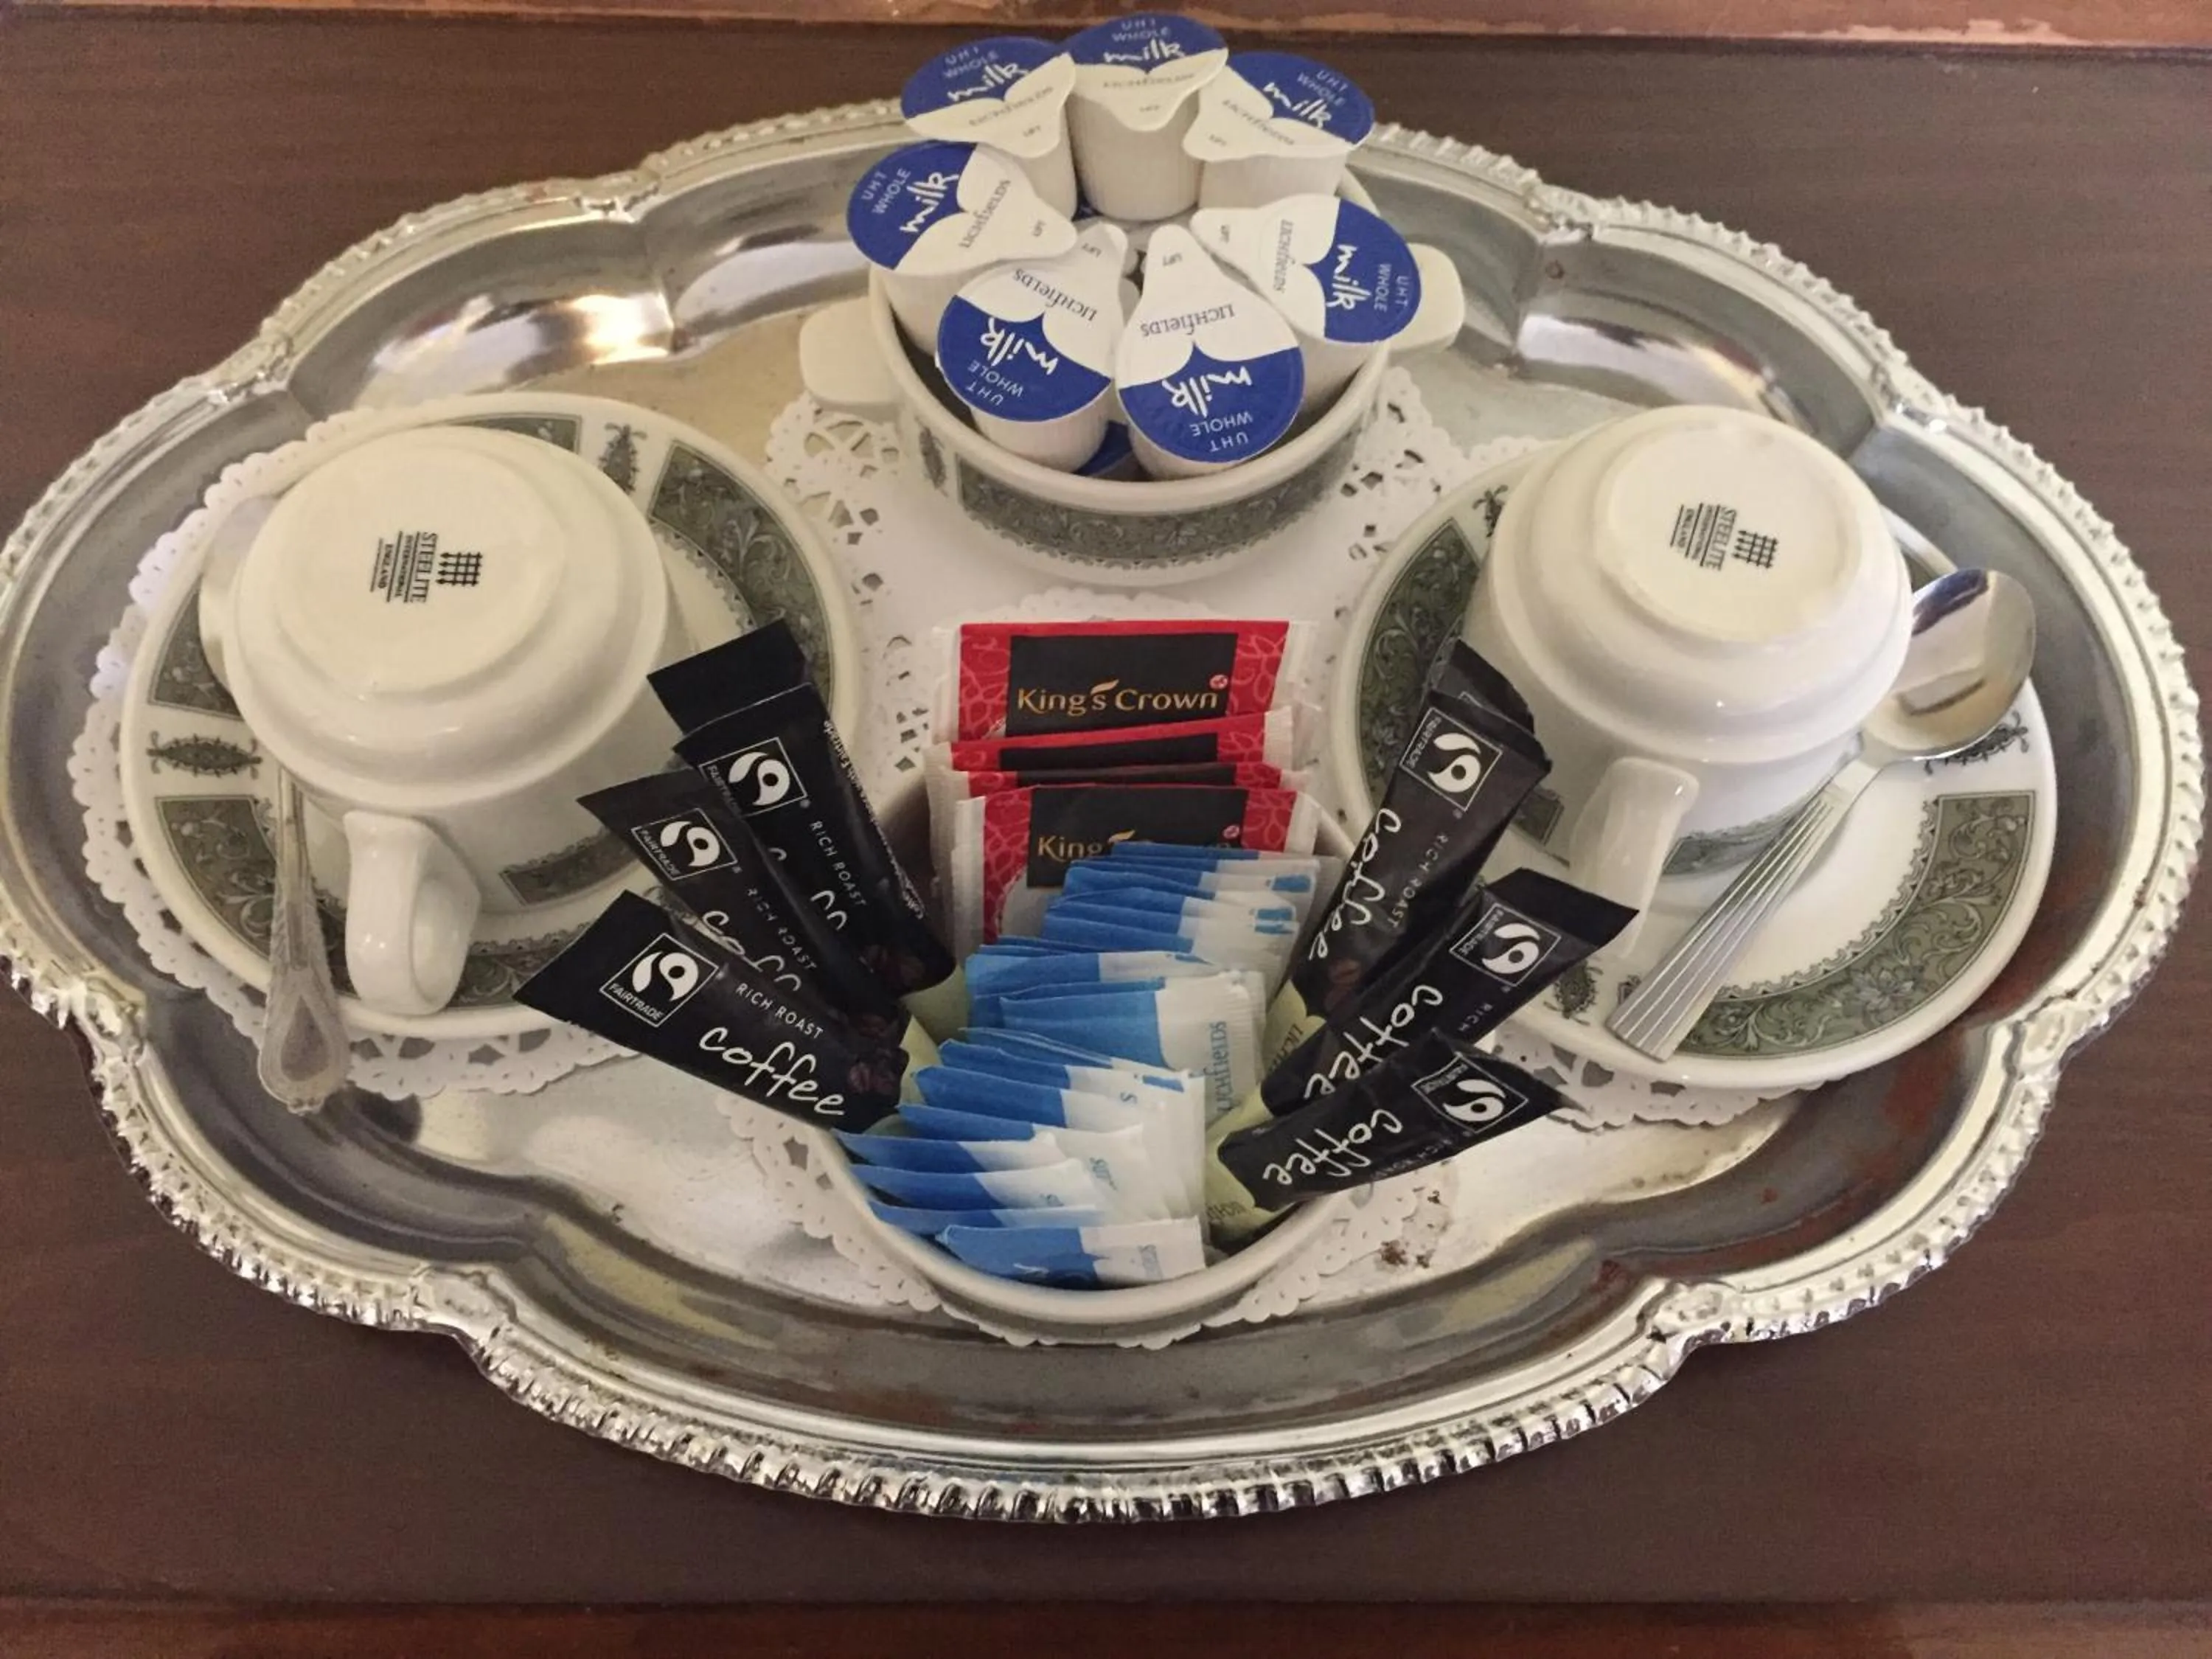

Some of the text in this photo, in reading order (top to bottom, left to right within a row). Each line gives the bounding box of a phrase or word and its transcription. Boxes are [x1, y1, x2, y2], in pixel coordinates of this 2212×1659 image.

[1104, 38, 1184, 62] milk
[1112, 27, 1170, 41] WHOLE
[943, 50, 999, 77] WHOLE
[947, 63, 1029, 102] milk
[1263, 83, 1332, 128] milk
[1298, 74, 1346, 107] WHOLE
[861, 170, 888, 201] UHT
[872, 168, 911, 215] WHOLE
[900, 172, 960, 233] milk
[1326, 244, 1371, 311] milk
[1374, 263, 1392, 312] WHOLE
[1395, 276, 1410, 309] UHT
[980, 317, 1059, 375] milk
[966, 382, 1004, 406] UHT
[967, 360, 1025, 397] WHOLE
[1162, 366, 1252, 418] milk
[1189, 411, 1253, 437] WHOLE
[1210, 434, 1248, 452] UHT
[1705, 506, 1737, 572] STEELITE
[378, 543, 394, 589] ENGLAND
[409, 532, 439, 603] STEELITE
[1018, 679, 1218, 716] King's Crown
[640, 830, 681, 875] FAIRTRADE
[811, 821, 838, 856] RICH
[832, 861, 866, 905] ROAST
[1308, 808, 1401, 960] coffee
[1387, 835, 1449, 928] RICH ROAST
[747, 888, 817, 969] RICH ROAST
[609, 983, 664, 1021] FAIRTRADE
[736, 983, 824, 1038] RICH ROAST
[1459, 1004, 1494, 1032] RICH
[1304, 985, 1443, 1099] coffee
[699, 1027, 844, 1115] coffee
[1262, 1109, 1402, 1185] coffee
